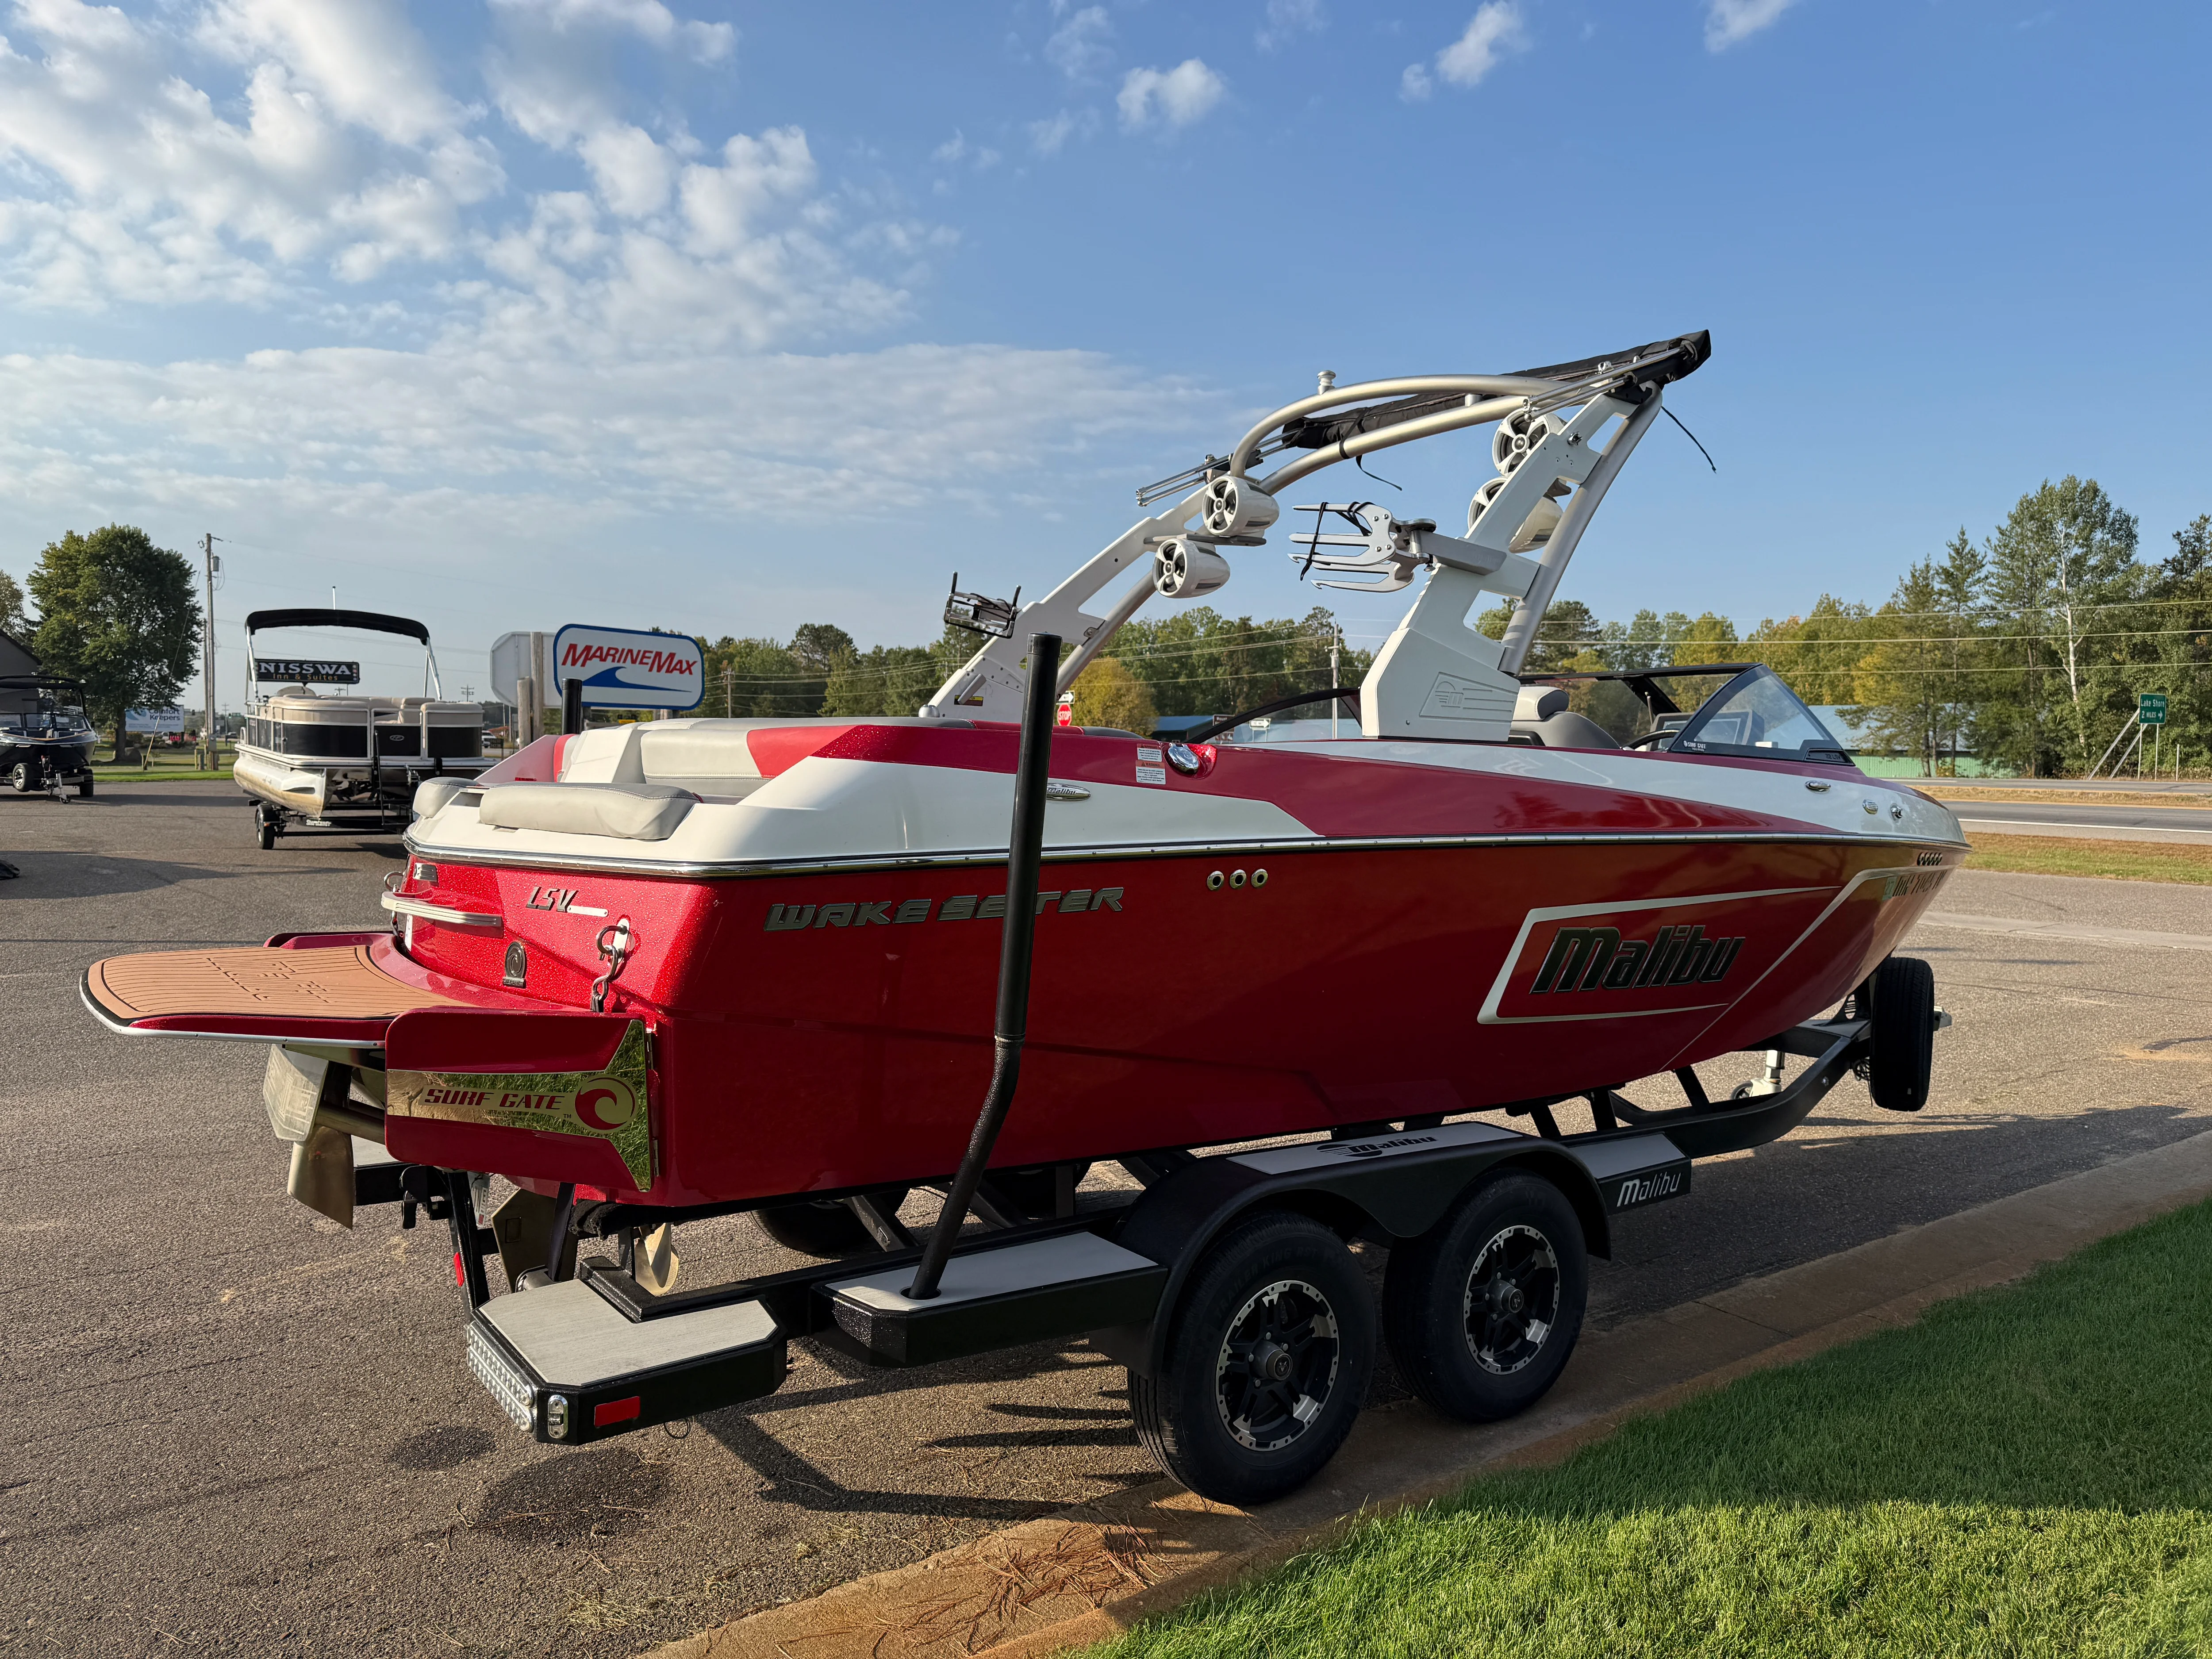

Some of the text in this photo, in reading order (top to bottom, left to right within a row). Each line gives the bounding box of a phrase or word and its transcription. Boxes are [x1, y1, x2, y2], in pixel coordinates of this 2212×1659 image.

[259, 663, 351, 675] NISSWA
[1058, 710, 1071, 720] STOP
[526, 886, 579, 913] LSV
[937, 887, 1125, 922] SETER
[424, 1089, 494, 1106] SURF
[499, 1094, 565, 1110] GATE
[1263, 1247, 1292, 1269] KING
